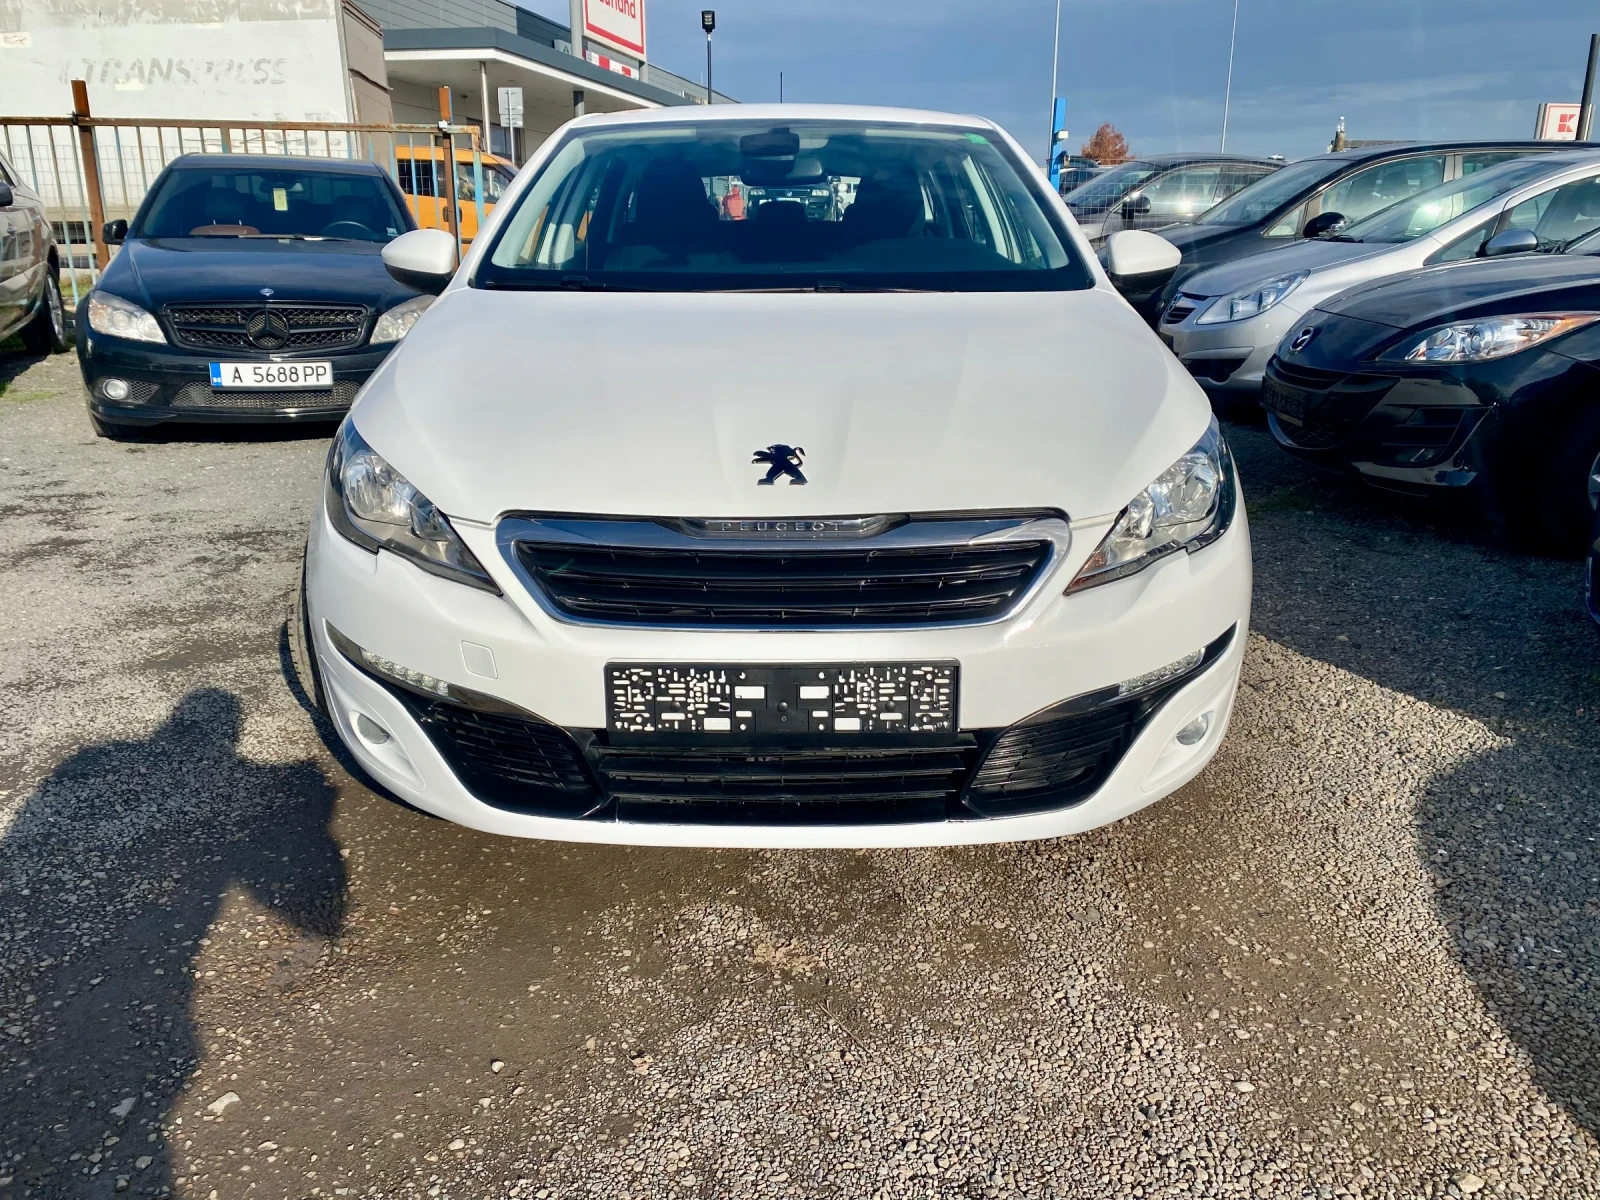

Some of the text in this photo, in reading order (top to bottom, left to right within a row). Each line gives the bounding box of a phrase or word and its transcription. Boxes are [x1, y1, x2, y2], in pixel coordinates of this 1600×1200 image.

[600, 0, 636, 19] land
[232, 366, 243, 383] A
[721, 520, 843, 531] PEUGEOT
